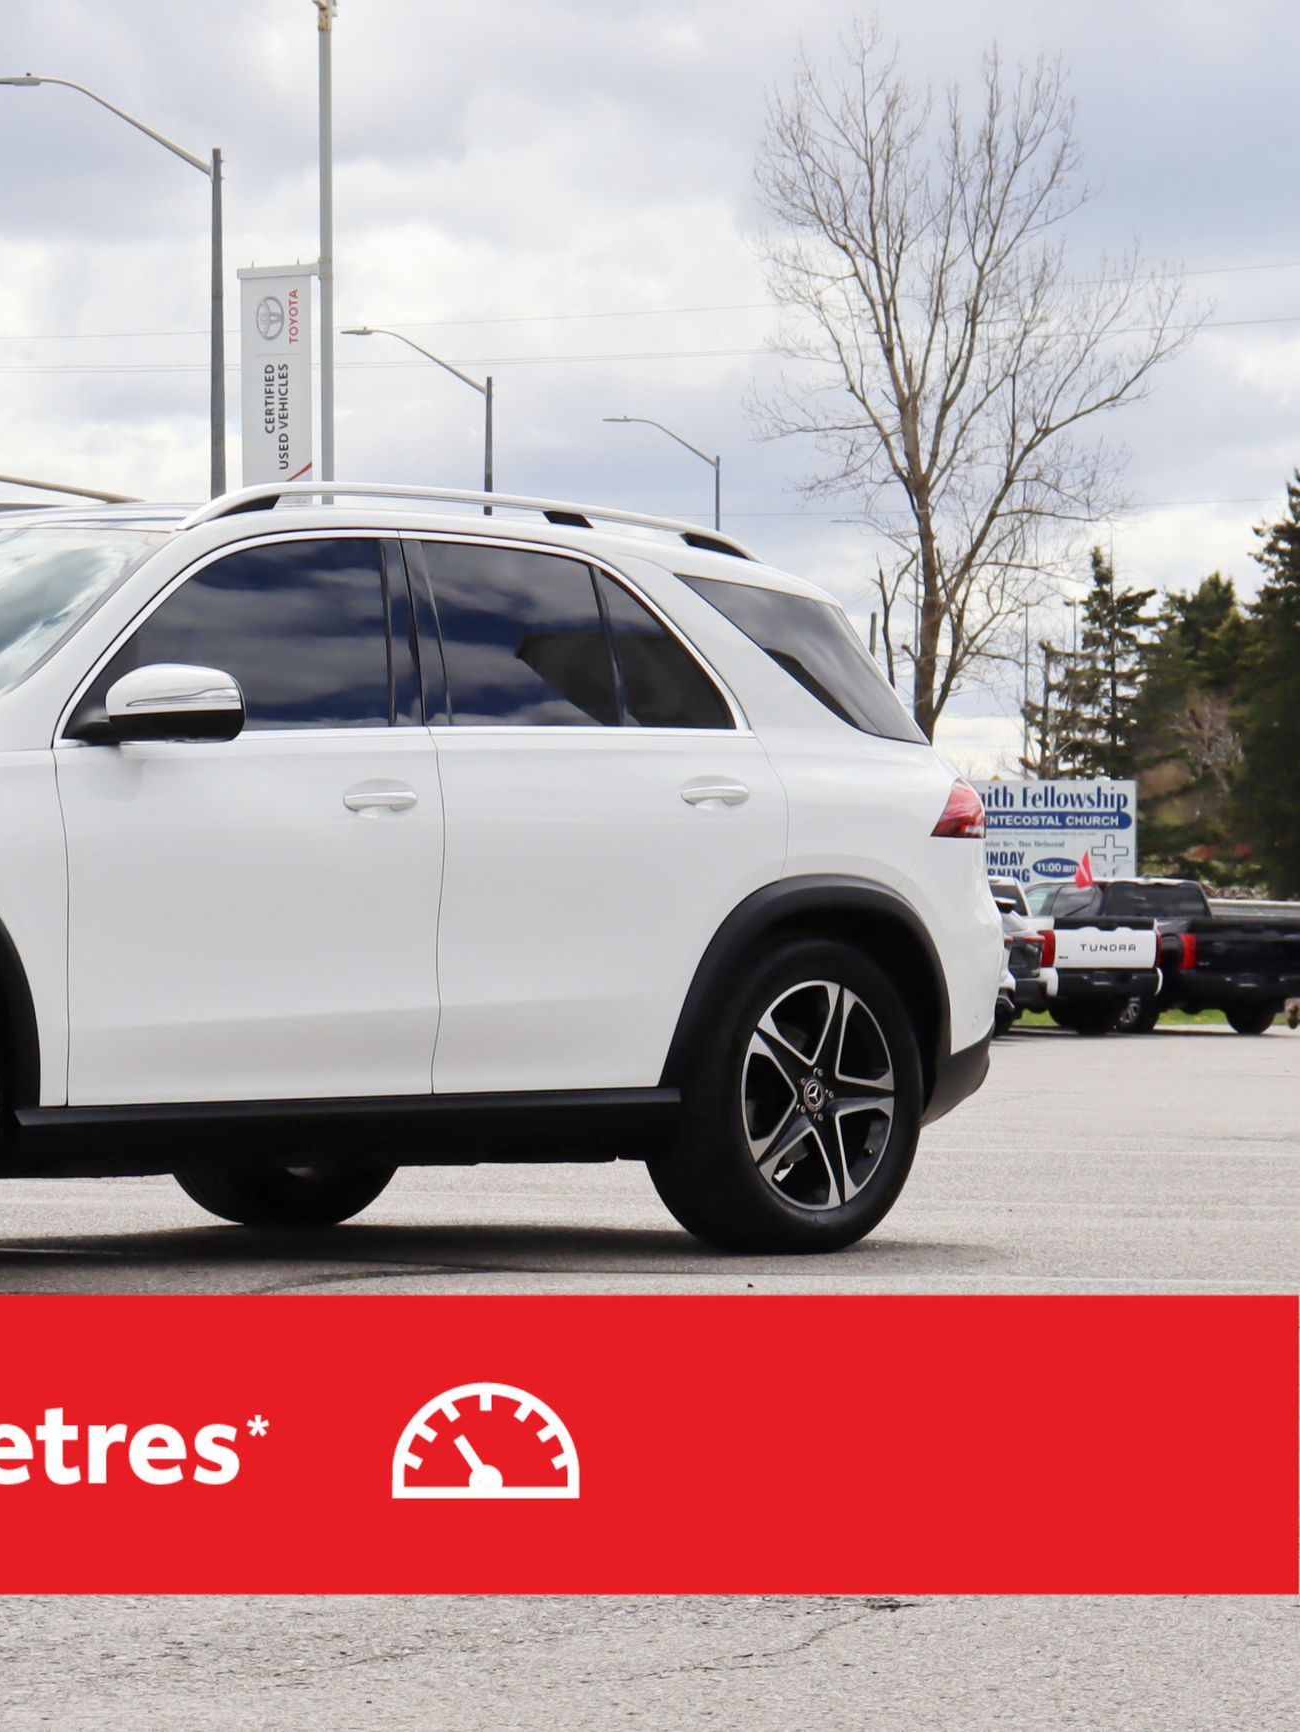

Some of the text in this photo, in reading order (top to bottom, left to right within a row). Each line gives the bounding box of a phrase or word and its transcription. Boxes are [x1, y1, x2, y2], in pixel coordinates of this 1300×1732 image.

[288, 289, 299, 345] TOYOTA
[264, 364, 276, 434] CERTIFIED
[278, 363, 289, 470] USED VEHICLES
[979, 785, 1128, 812] aith Fellowship
[986, 815, 1119, 826] NTECOSTAL CHURCH
[986, 851, 1025, 866] NDAY
[987, 868, 1030, 882] RNING
[1036, 863, 1062, 872] 11:00
[1080, 944, 1137, 952] TUNDRA
